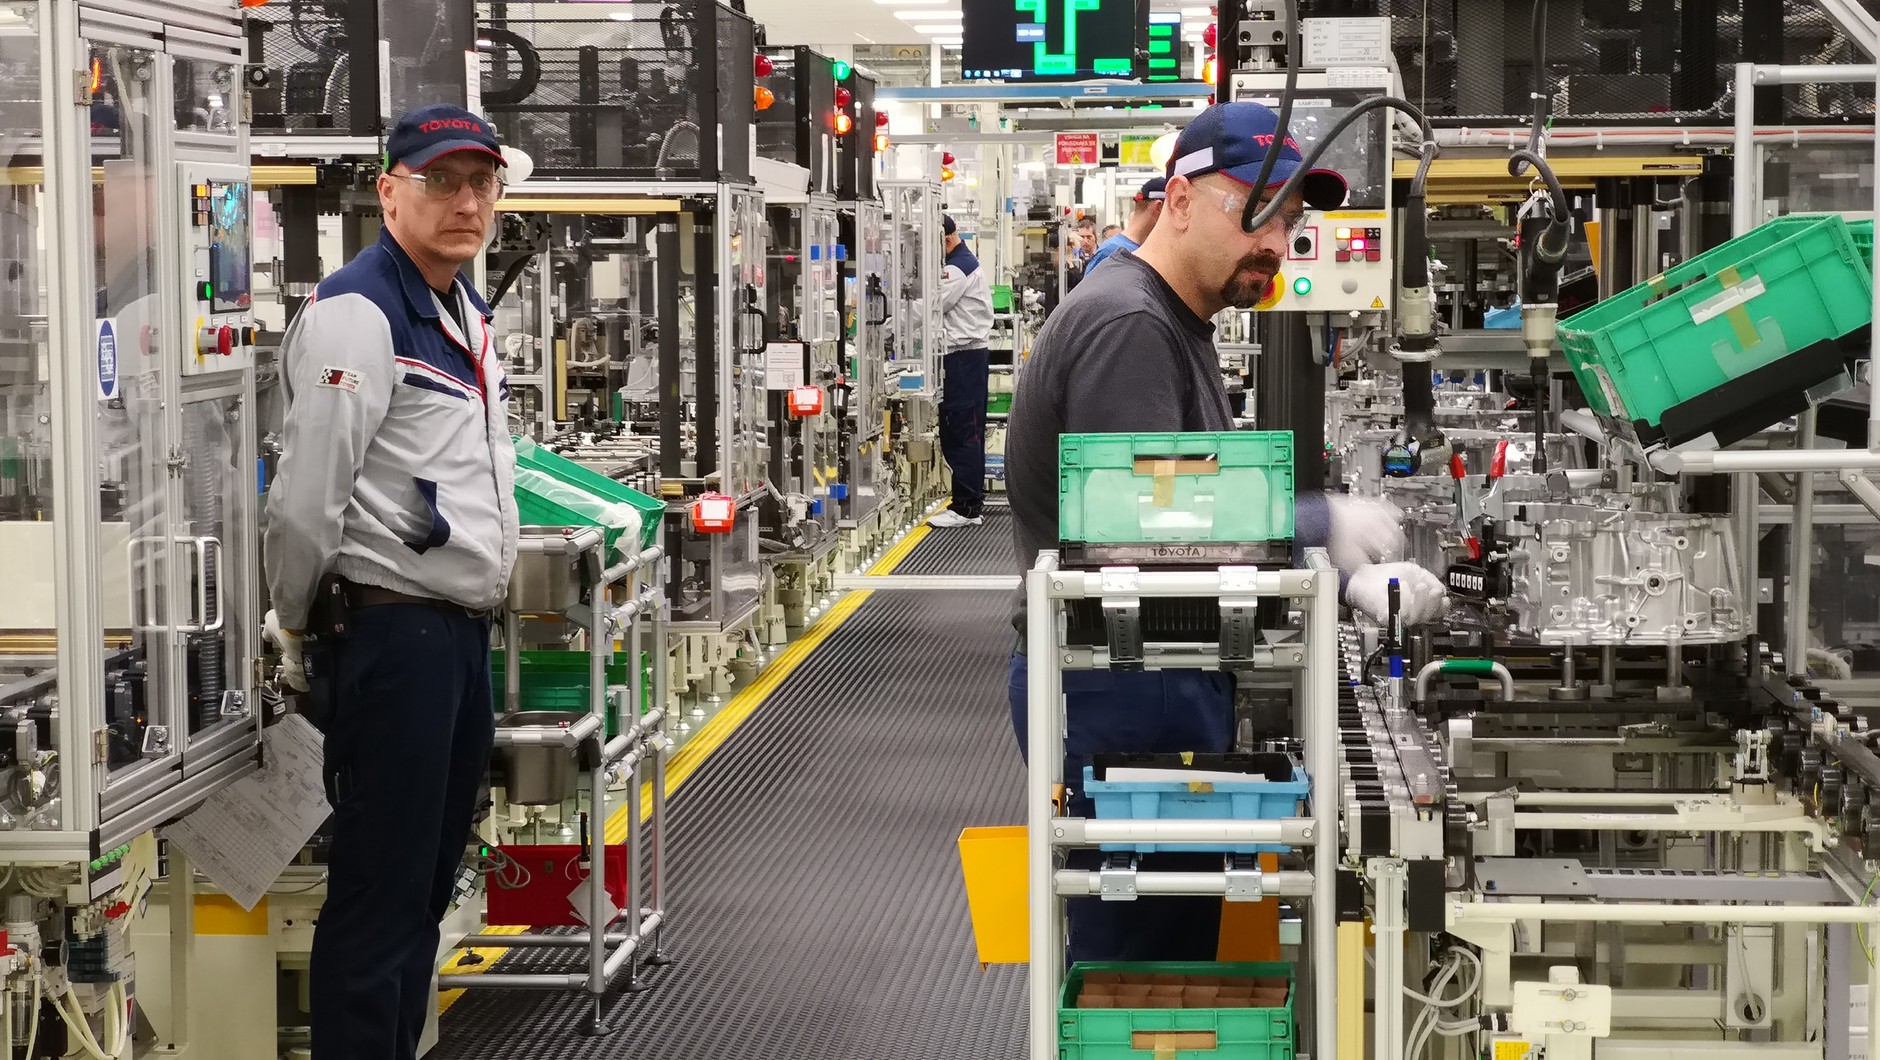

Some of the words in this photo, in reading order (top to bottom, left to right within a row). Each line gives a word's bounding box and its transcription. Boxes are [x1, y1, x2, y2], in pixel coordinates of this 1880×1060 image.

[418, 119, 482, 134] TOYOTA
[340, 381, 356, 389] TOYOTA
[342, 376, 359, 385] FUTURE
[1151, 547, 1200, 557] TOYOTA
